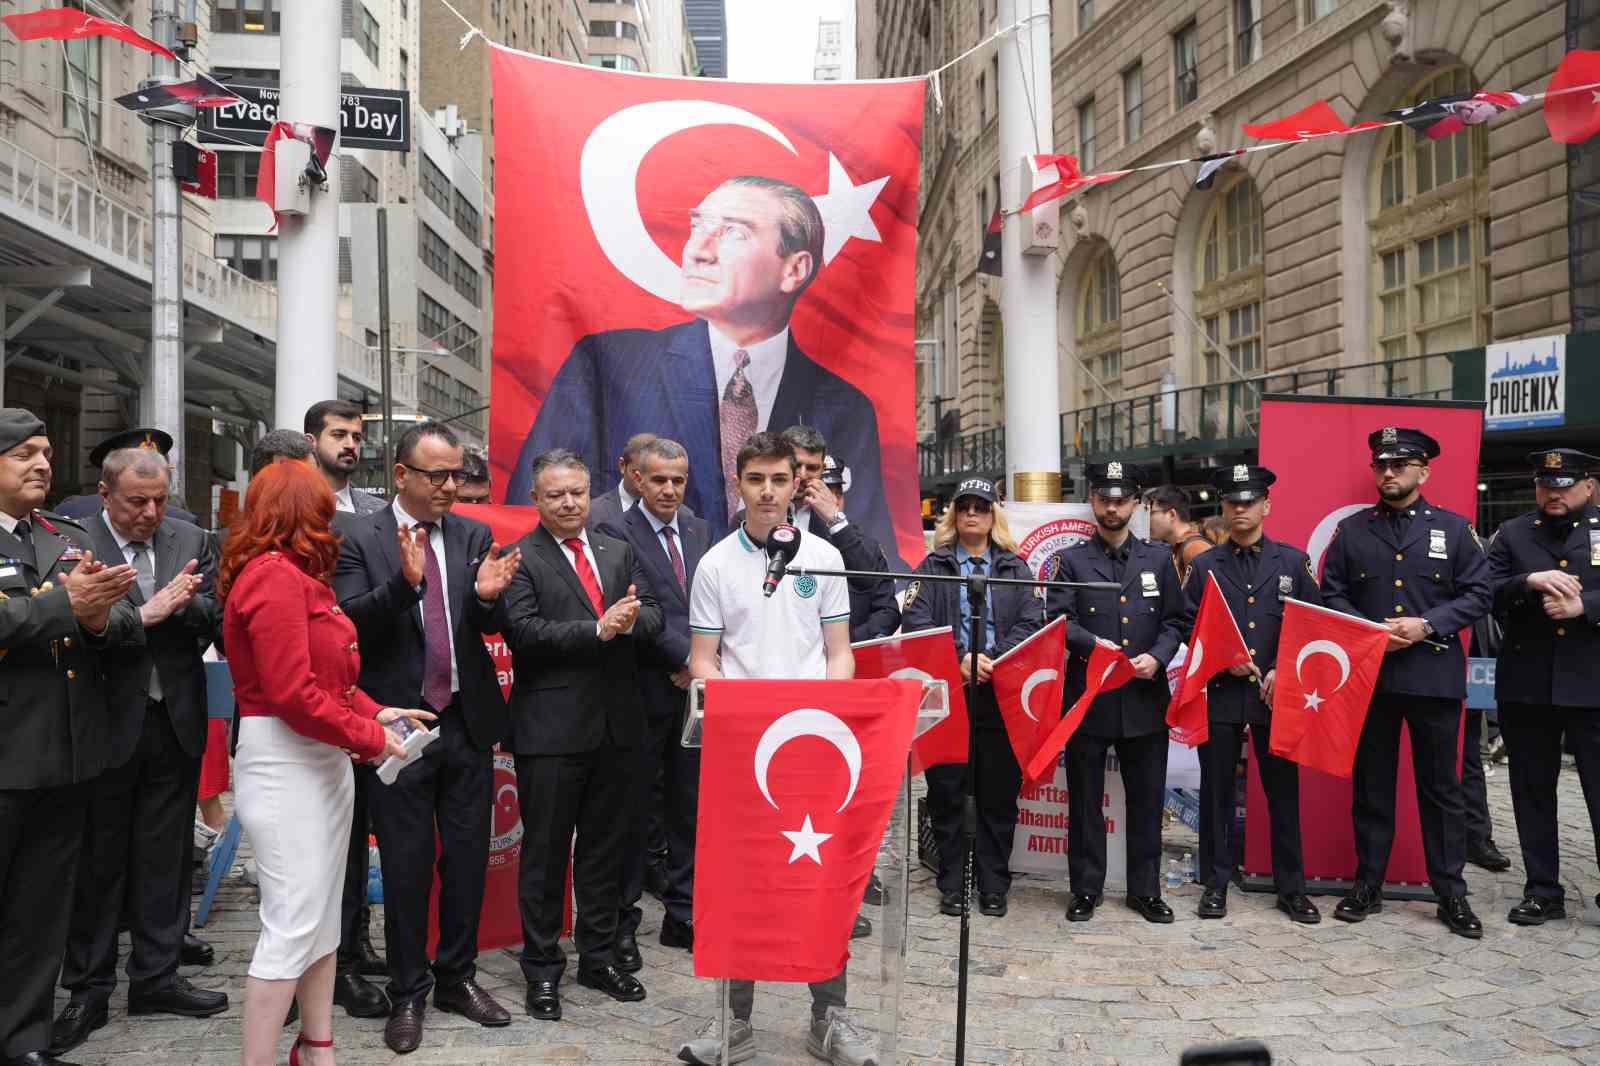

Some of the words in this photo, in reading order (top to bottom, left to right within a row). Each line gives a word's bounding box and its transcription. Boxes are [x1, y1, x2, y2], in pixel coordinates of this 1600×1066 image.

[260, 89, 281, 100] Nov
[339, 95, 360, 106] 783
[355, 106, 398, 136] Day
[1490, 376, 1559, 416] PHOENIX
[960, 479, 991, 492] NYPD
[1018, 522, 1060, 557] TURKISH
[1060, 521, 1097, 537] AMERI
